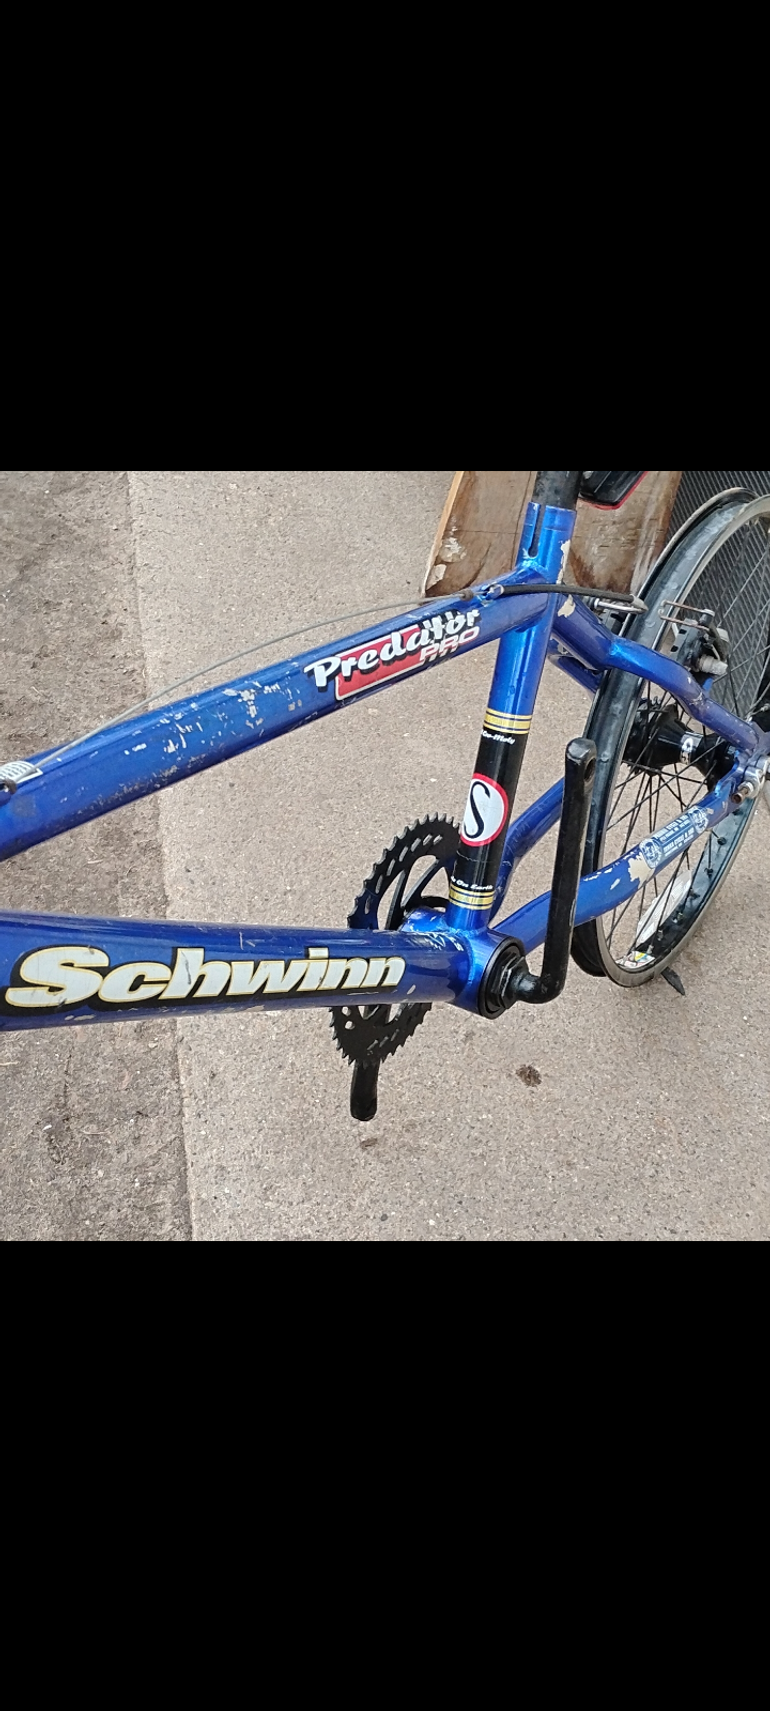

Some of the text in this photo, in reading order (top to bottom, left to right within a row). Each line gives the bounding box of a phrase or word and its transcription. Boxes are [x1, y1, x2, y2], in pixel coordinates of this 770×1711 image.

[303, 609, 481, 689] Predator
[419, 626, 480, 662] PRO
[463, 780, 491, 840] S
[5, 946, 406, 1008] Schwinn
